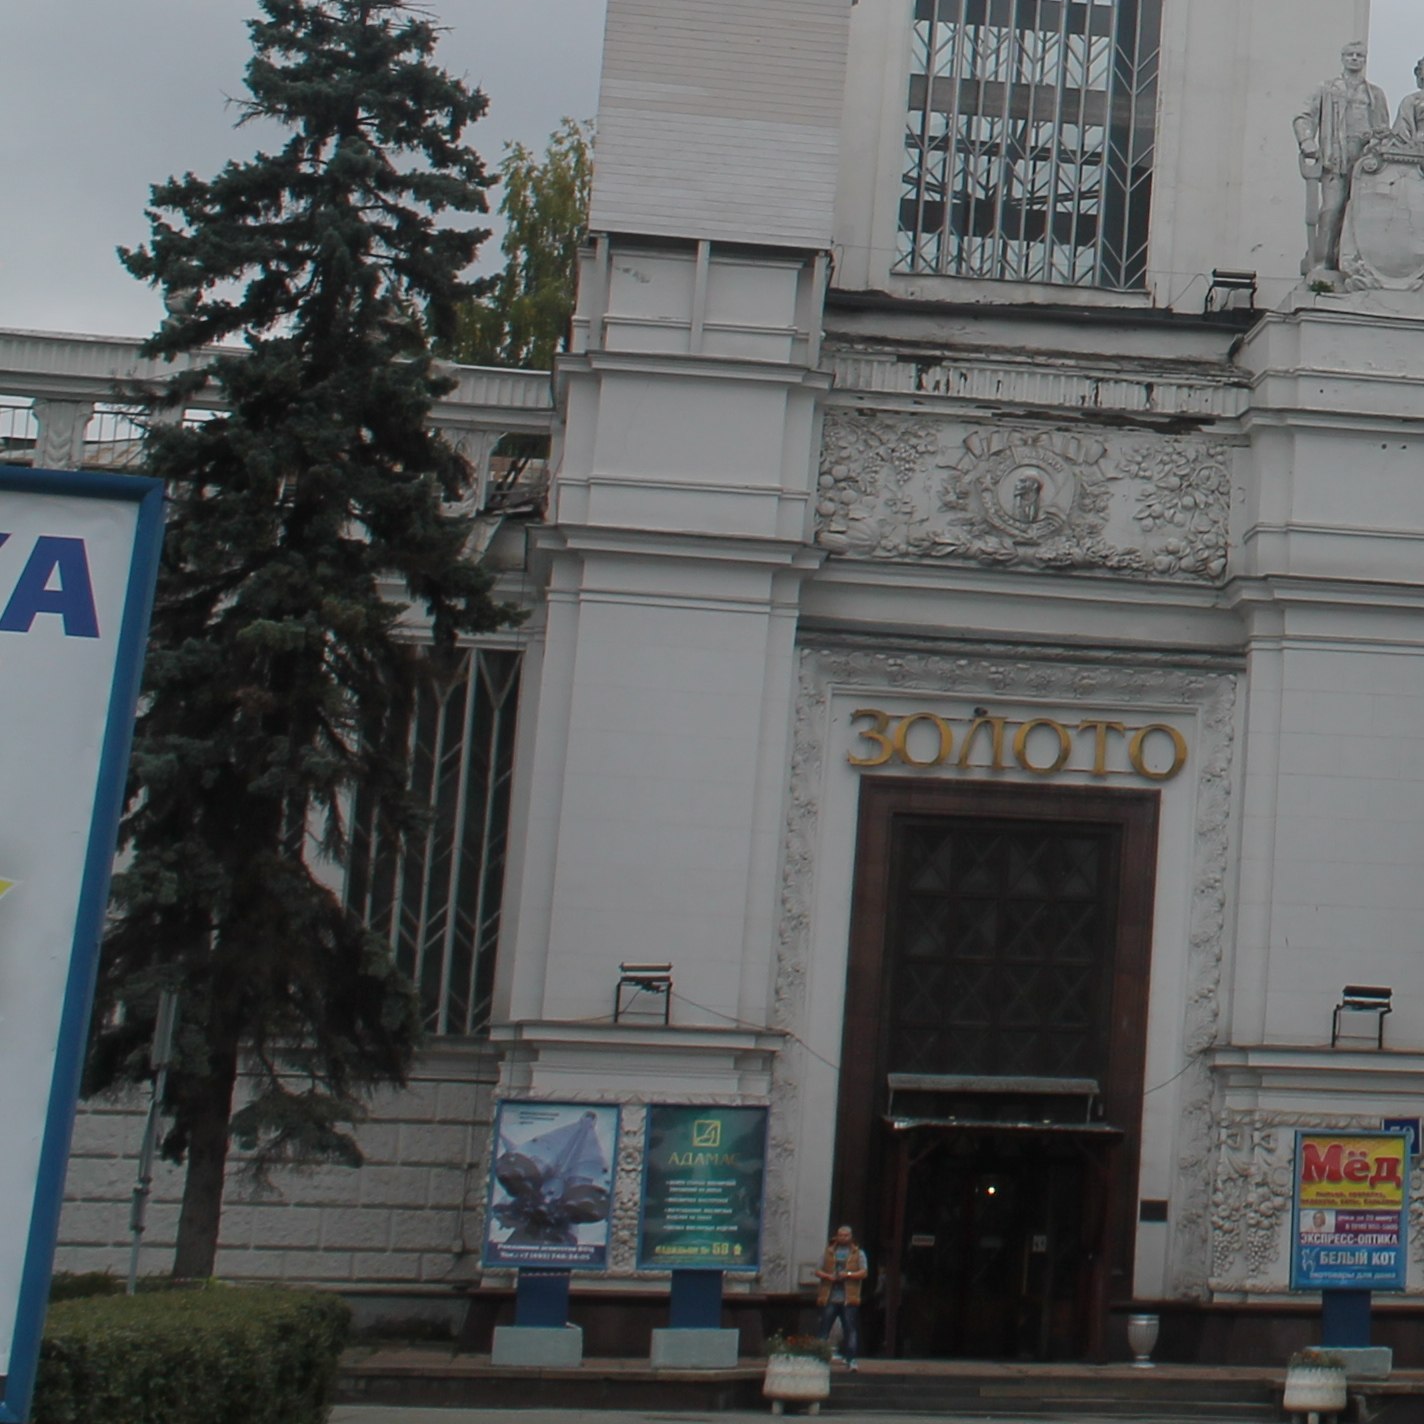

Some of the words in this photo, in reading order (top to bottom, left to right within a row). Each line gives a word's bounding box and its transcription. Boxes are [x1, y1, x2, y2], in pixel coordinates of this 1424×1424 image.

[0, 533, 101, 639] А
[847, 708, 1189, 781] ЗОЛОТО
[1301, 1143, 1403, 1190] Мёд
[1301, 1233, 1398, 1245] ЭКСПРЕСС-ОПТИКА
[1320, 1249, 1368, 1265] БЕЛЫЙ
[1371, 1251, 1396, 1266] КОТ
